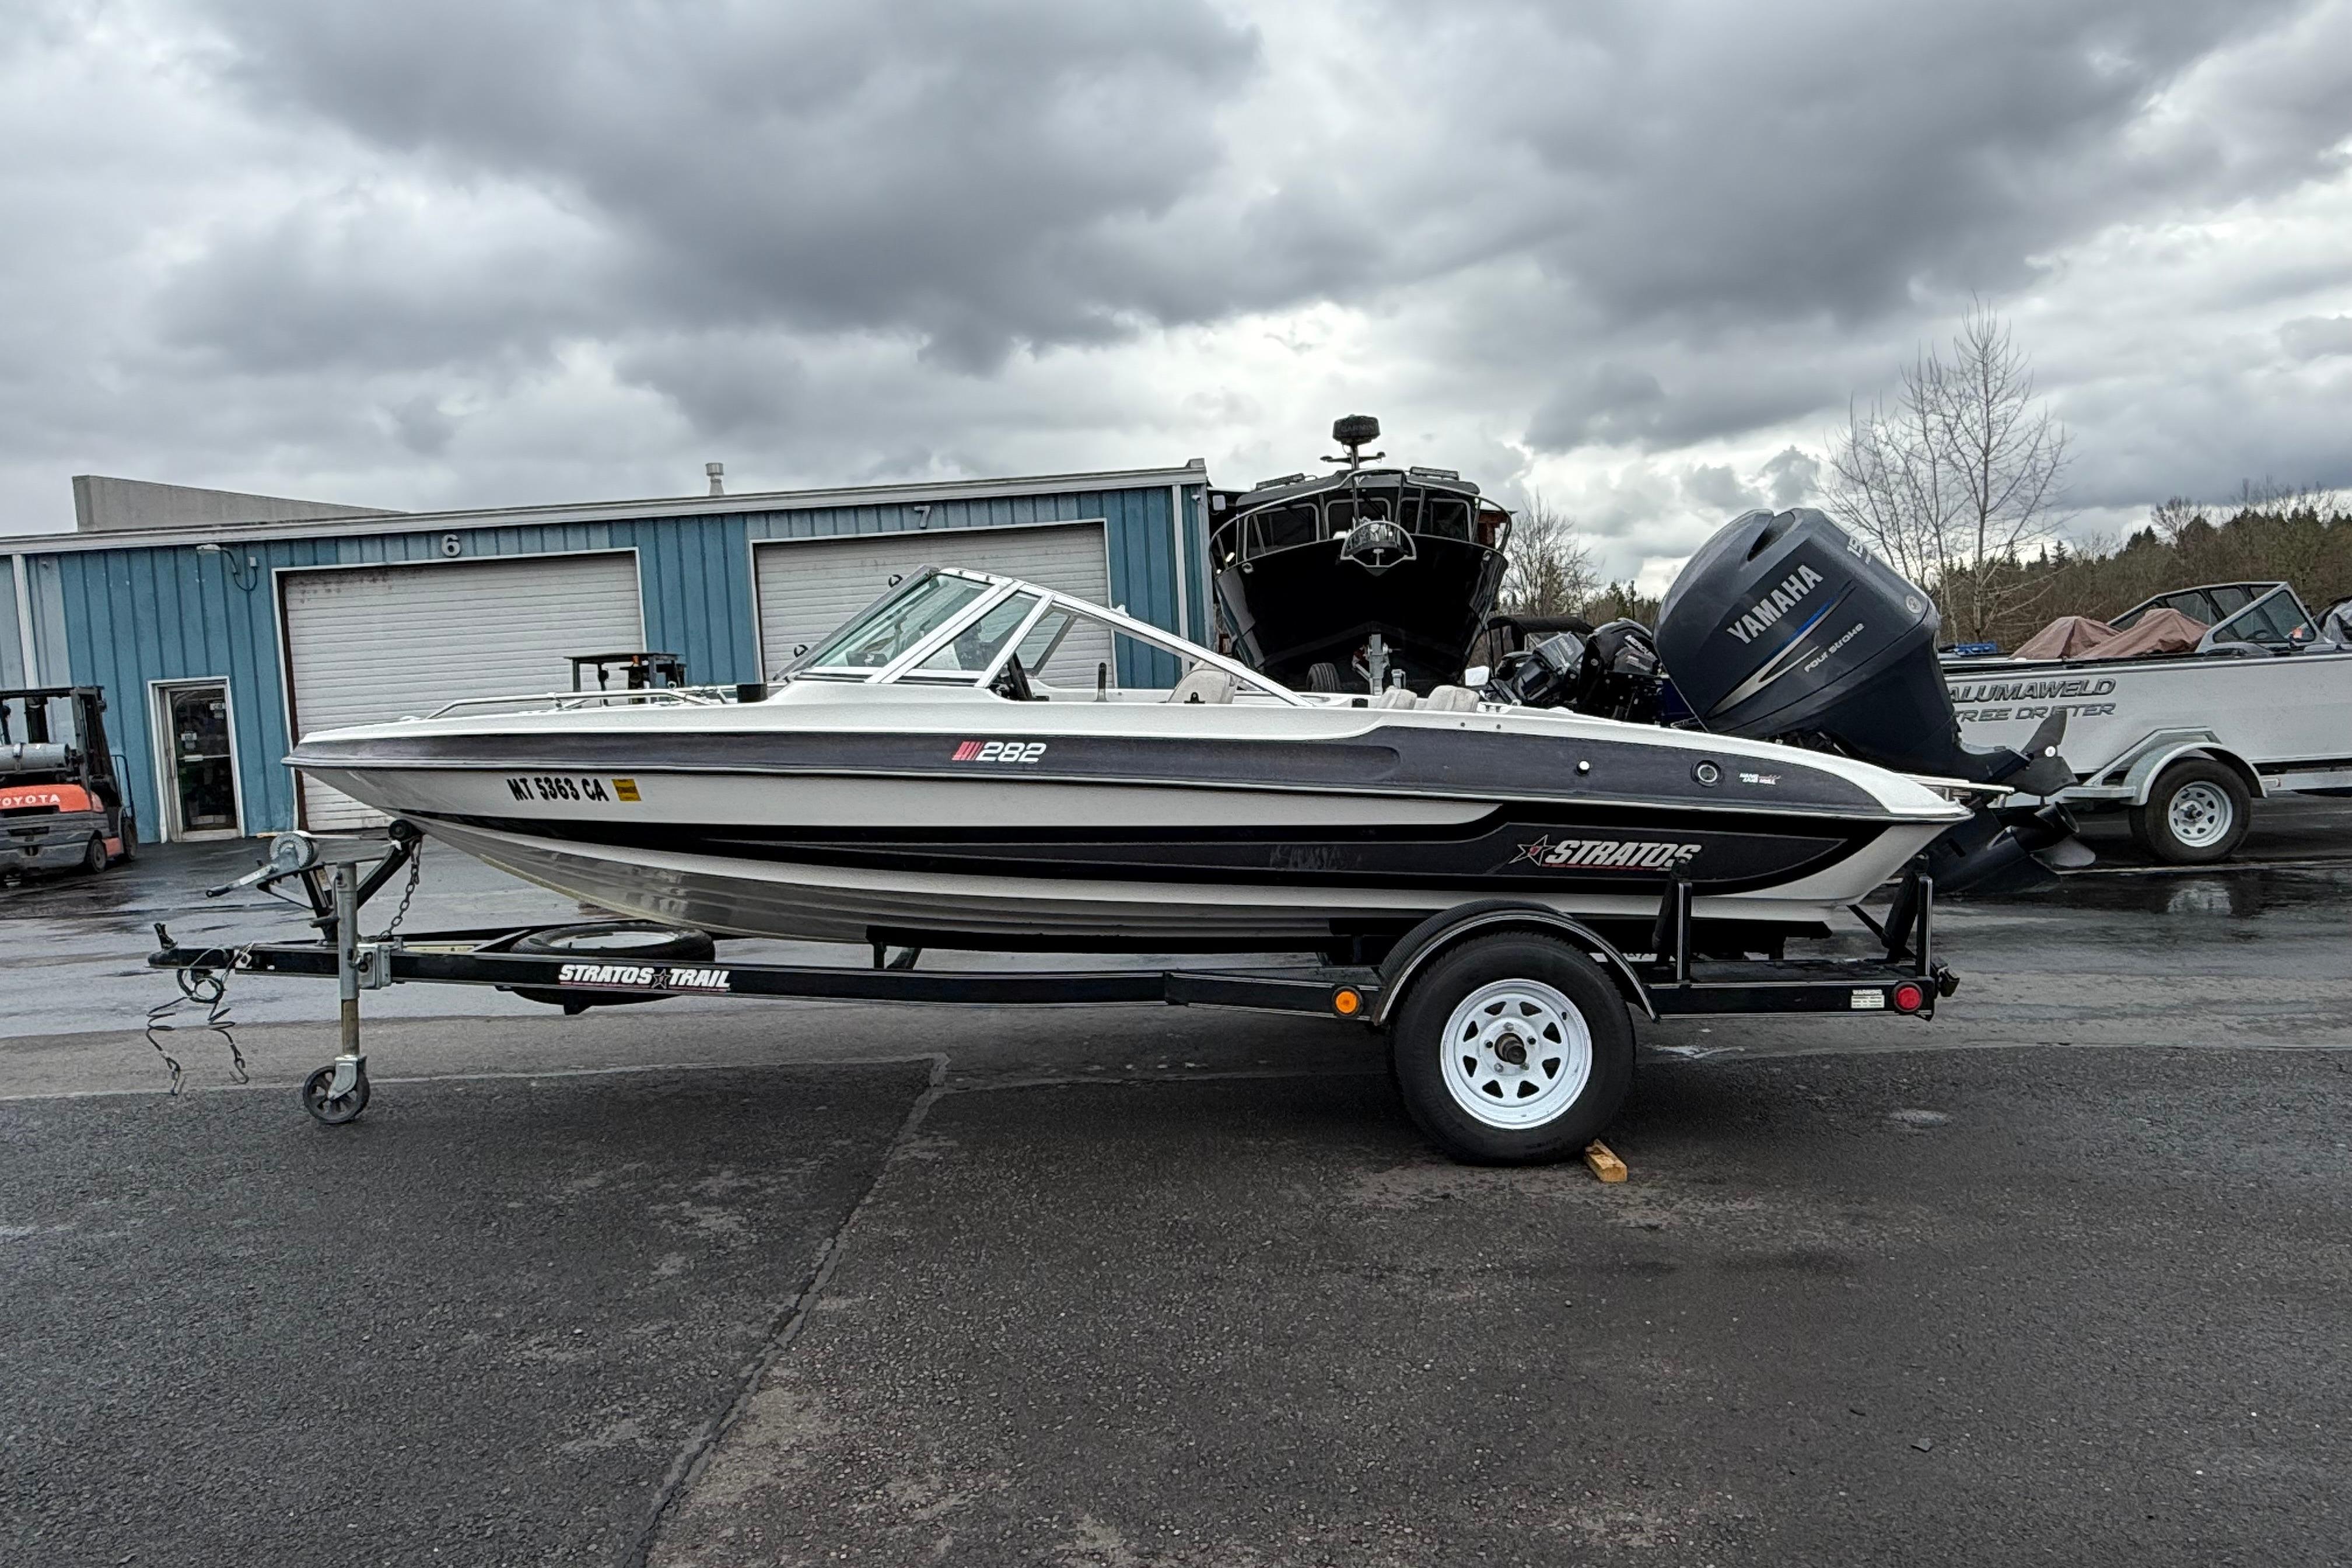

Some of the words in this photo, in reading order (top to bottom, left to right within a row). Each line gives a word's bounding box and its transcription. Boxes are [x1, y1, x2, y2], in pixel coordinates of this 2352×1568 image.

[914, 505, 931, 528] 7
[441, 534, 460, 556] 6
[1726, 564, 1824, 644] YAMAHA
[1948, 678, 2116, 703] ALUMAWELD
[975, 741, 1046, 762] 282
[506, 778, 534, 802] MT
[533, 776, 580, 801] 5363
[581, 778, 610, 802] CA
[1545, 840, 1702, 867] STRATOS
[558, 964, 654, 984] STRATOS
[668, 968, 730, 988] TRAIL
